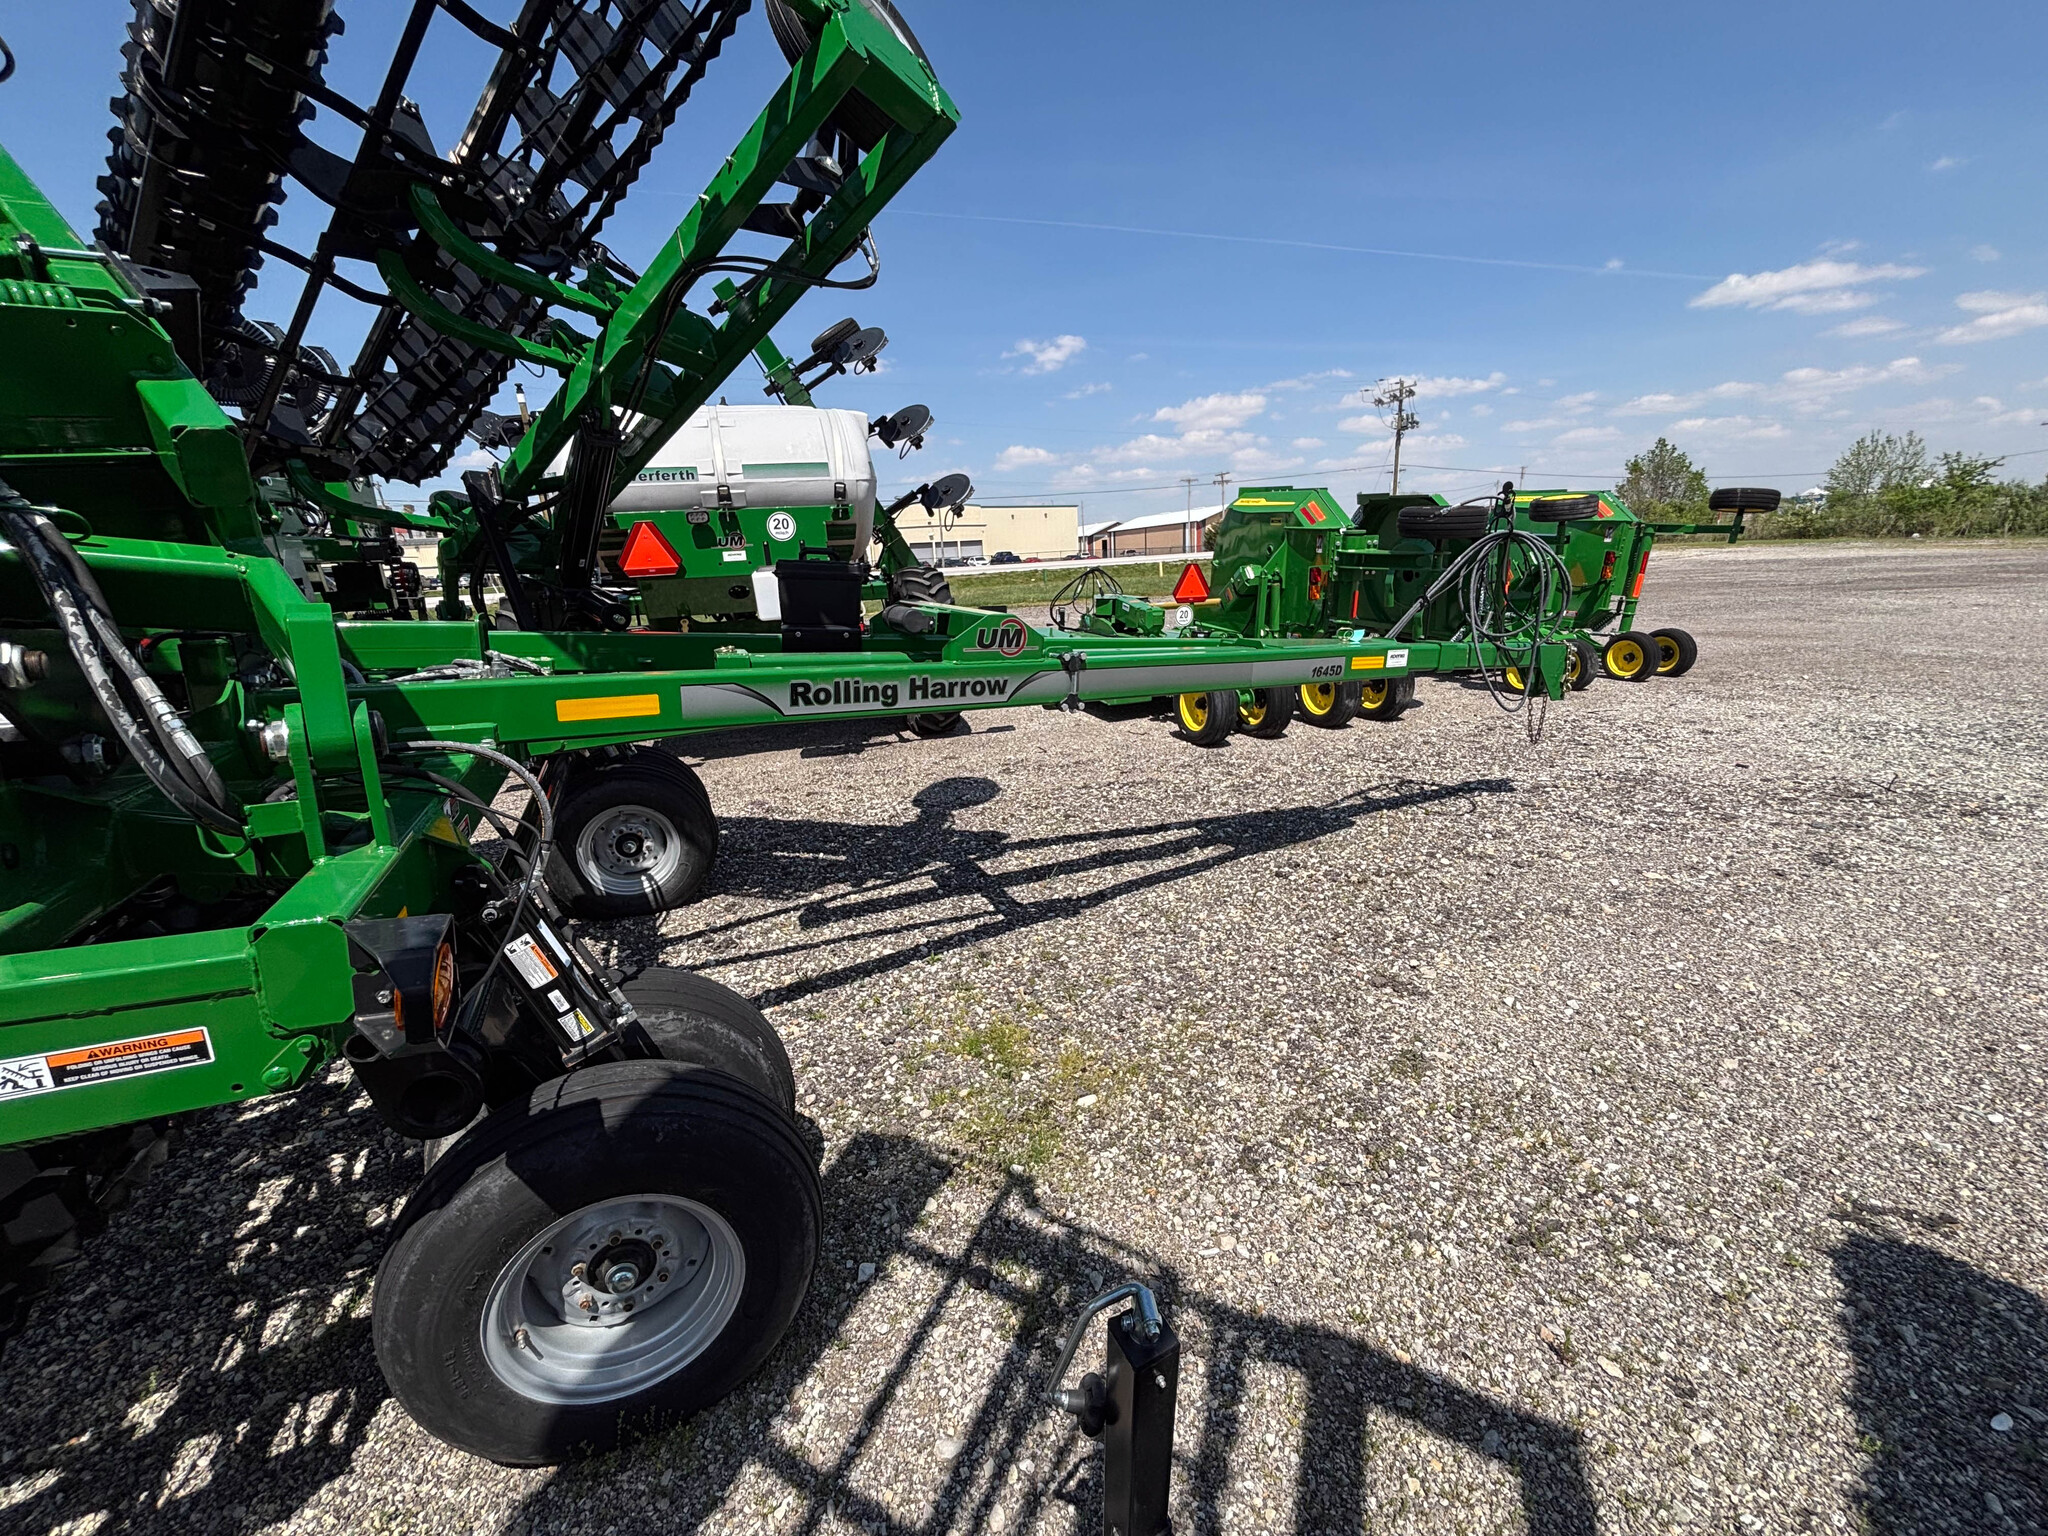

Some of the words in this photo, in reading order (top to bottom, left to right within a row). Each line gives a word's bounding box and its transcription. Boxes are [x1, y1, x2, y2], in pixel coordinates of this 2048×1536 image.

[631, 470, 695, 482] erferth
[773, 518, 789, 530] 20
[717, 533, 745, 548] UM
[1179, 610, 1189, 619] 20
[976, 624, 1025, 651] UM
[1311, 664, 1343, 678] 1645D
[789, 679, 899, 708] Rolling
[909, 676, 1009, 700] Harrow
[98, 1038, 169, 1057] WARNING
[171, 1044, 191, 1052] CAUSE
